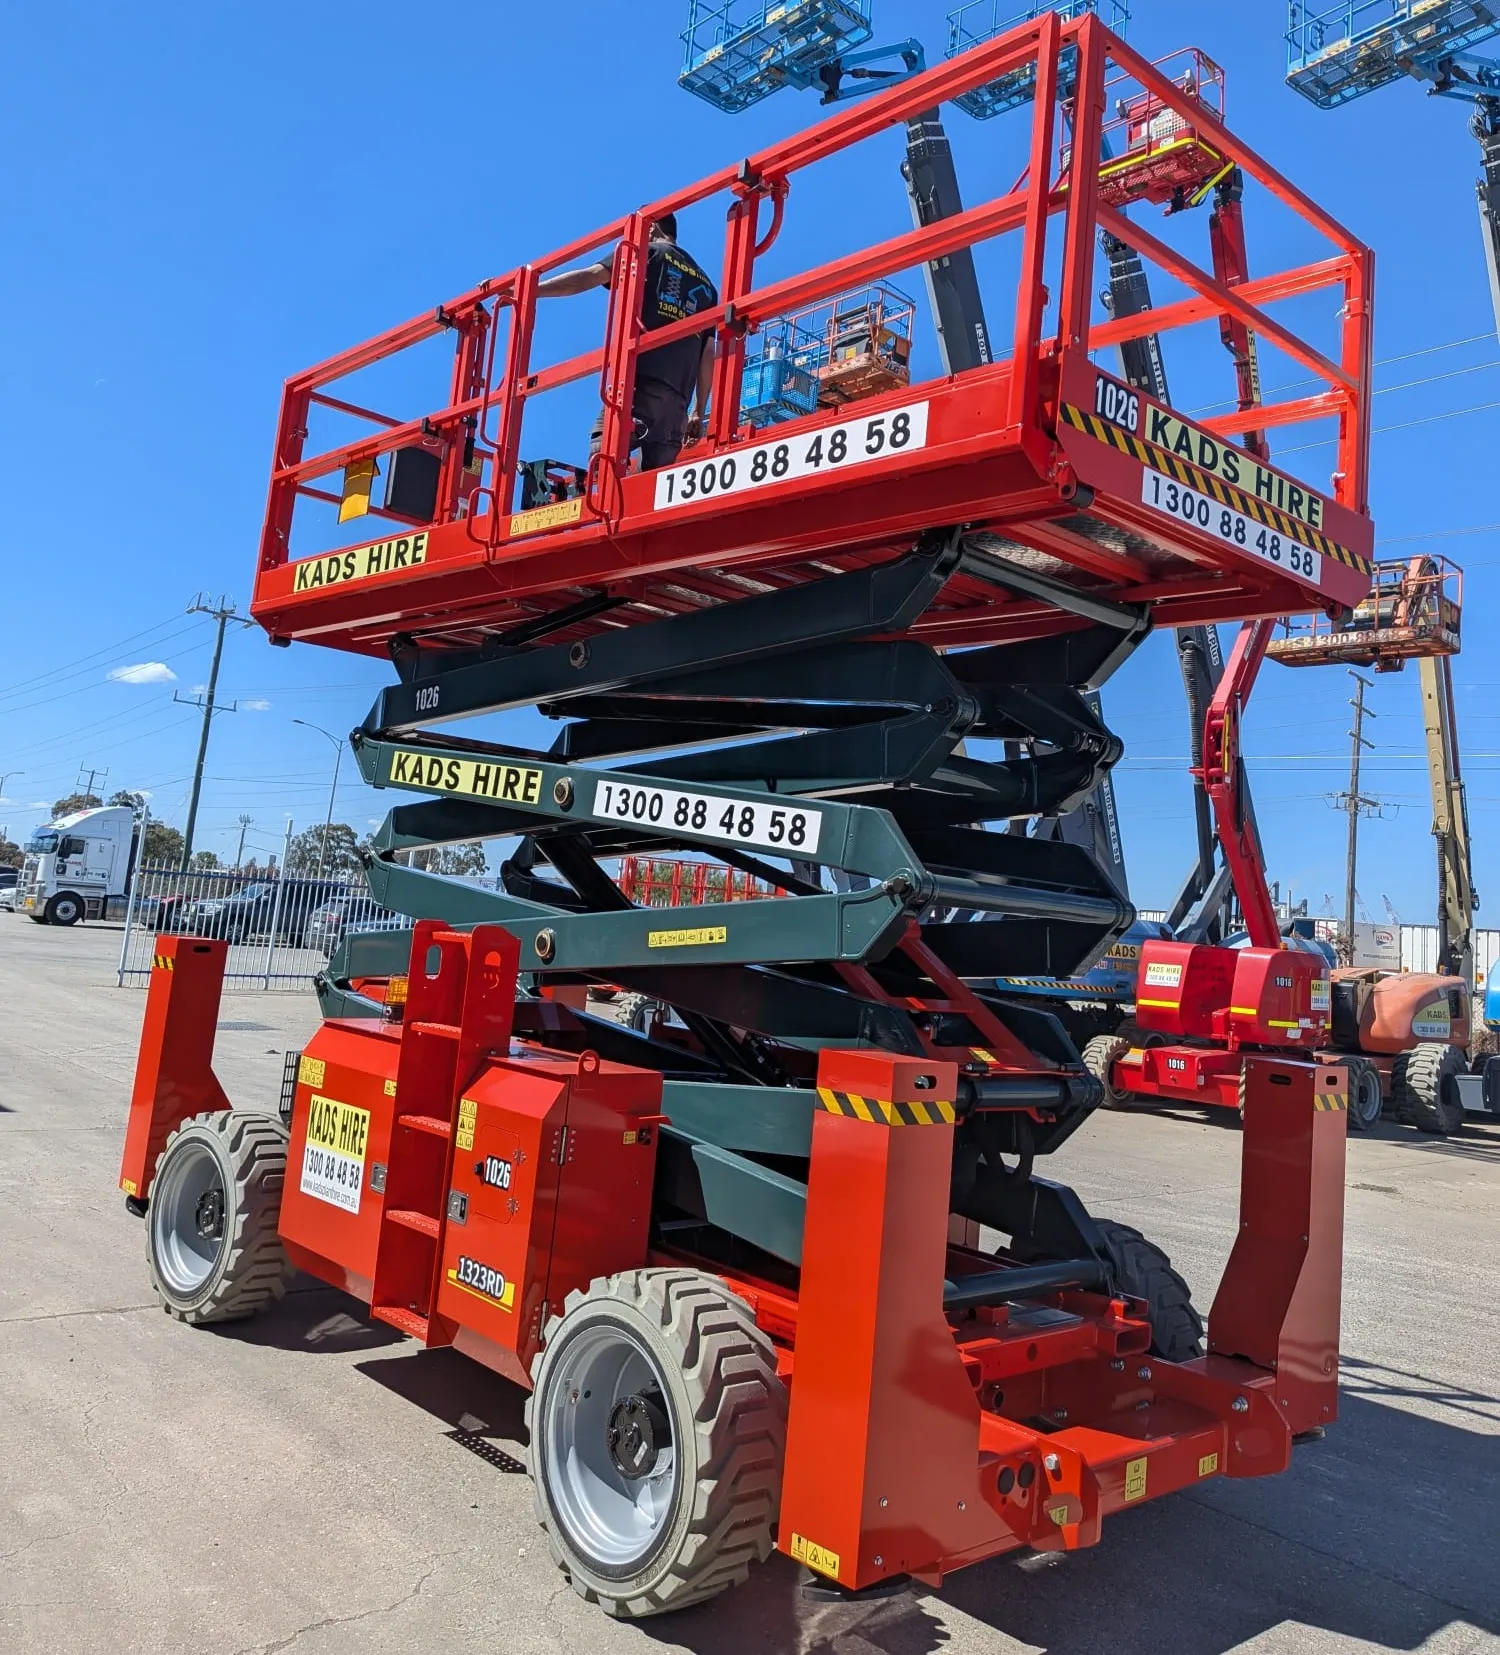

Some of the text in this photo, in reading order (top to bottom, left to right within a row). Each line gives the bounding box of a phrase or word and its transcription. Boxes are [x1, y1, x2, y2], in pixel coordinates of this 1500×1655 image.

[658, 302, 678, 314] 1300
[1096, 377, 1139, 432] 1026
[666, 412, 911, 503] 1300 88 48 58
[1152, 409, 1321, 529] KADS HIRE
[1152, 476, 1313, 577] 1300 88 48 58
[296, 533, 426, 591] KADS HIRE
[415, 685, 440, 712] 1026
[394, 753, 539, 802] KADS HIRE
[604, 786, 807, 846] 1300 88 48 58
[1276, 977, 1292, 987] 1016
[1168, 1058, 1185, 1070] 1016
[308, 1099, 367, 1156] KADS HIRE
[304, 1147, 360, 1191] 1300 88 48 58
[484, 1156, 511, 1189] 1026
[457, 1256, 505, 1298] 1323RD
